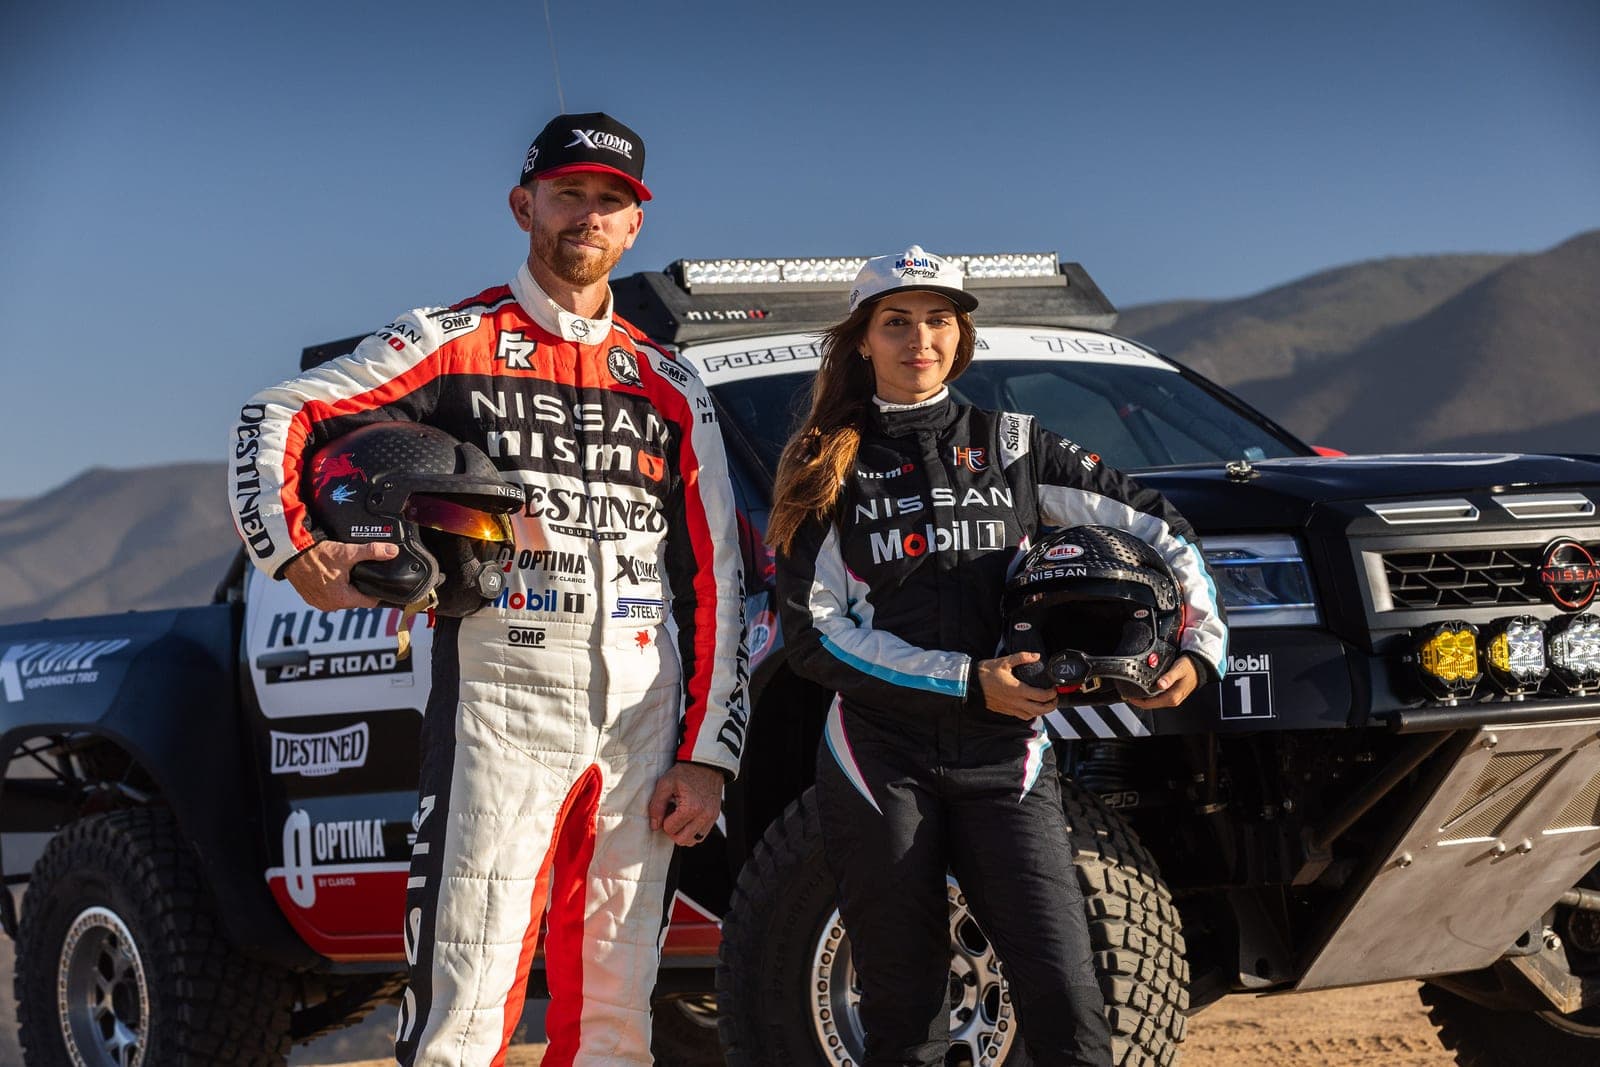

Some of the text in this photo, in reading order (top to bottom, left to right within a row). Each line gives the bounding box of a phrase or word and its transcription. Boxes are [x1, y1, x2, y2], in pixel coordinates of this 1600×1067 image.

[895, 258, 928, 269] Mobil
[901, 267, 937, 278] Racing
[442, 316, 472, 330] OMP
[471, 390, 670, 445] NISSAN
[1007, 415, 1021, 451] Sabelt
[487, 430, 665, 482] nismo
[857, 463, 914, 479] nismo
[236, 404, 275, 558] DESTINED
[523, 483, 666, 533] ESTINED
[855, 487, 1013, 524] NISSAN
[870, 520, 970, 564] Mobil
[518, 549, 586, 575] OPTIMA
[1030, 568, 1087, 581] NISSAN
[508, 630, 545, 644] OMP
[330, 653, 397, 674] ROAD
[275, 729, 365, 768] DESTINED
[315, 819, 386, 861] OPTIMA
